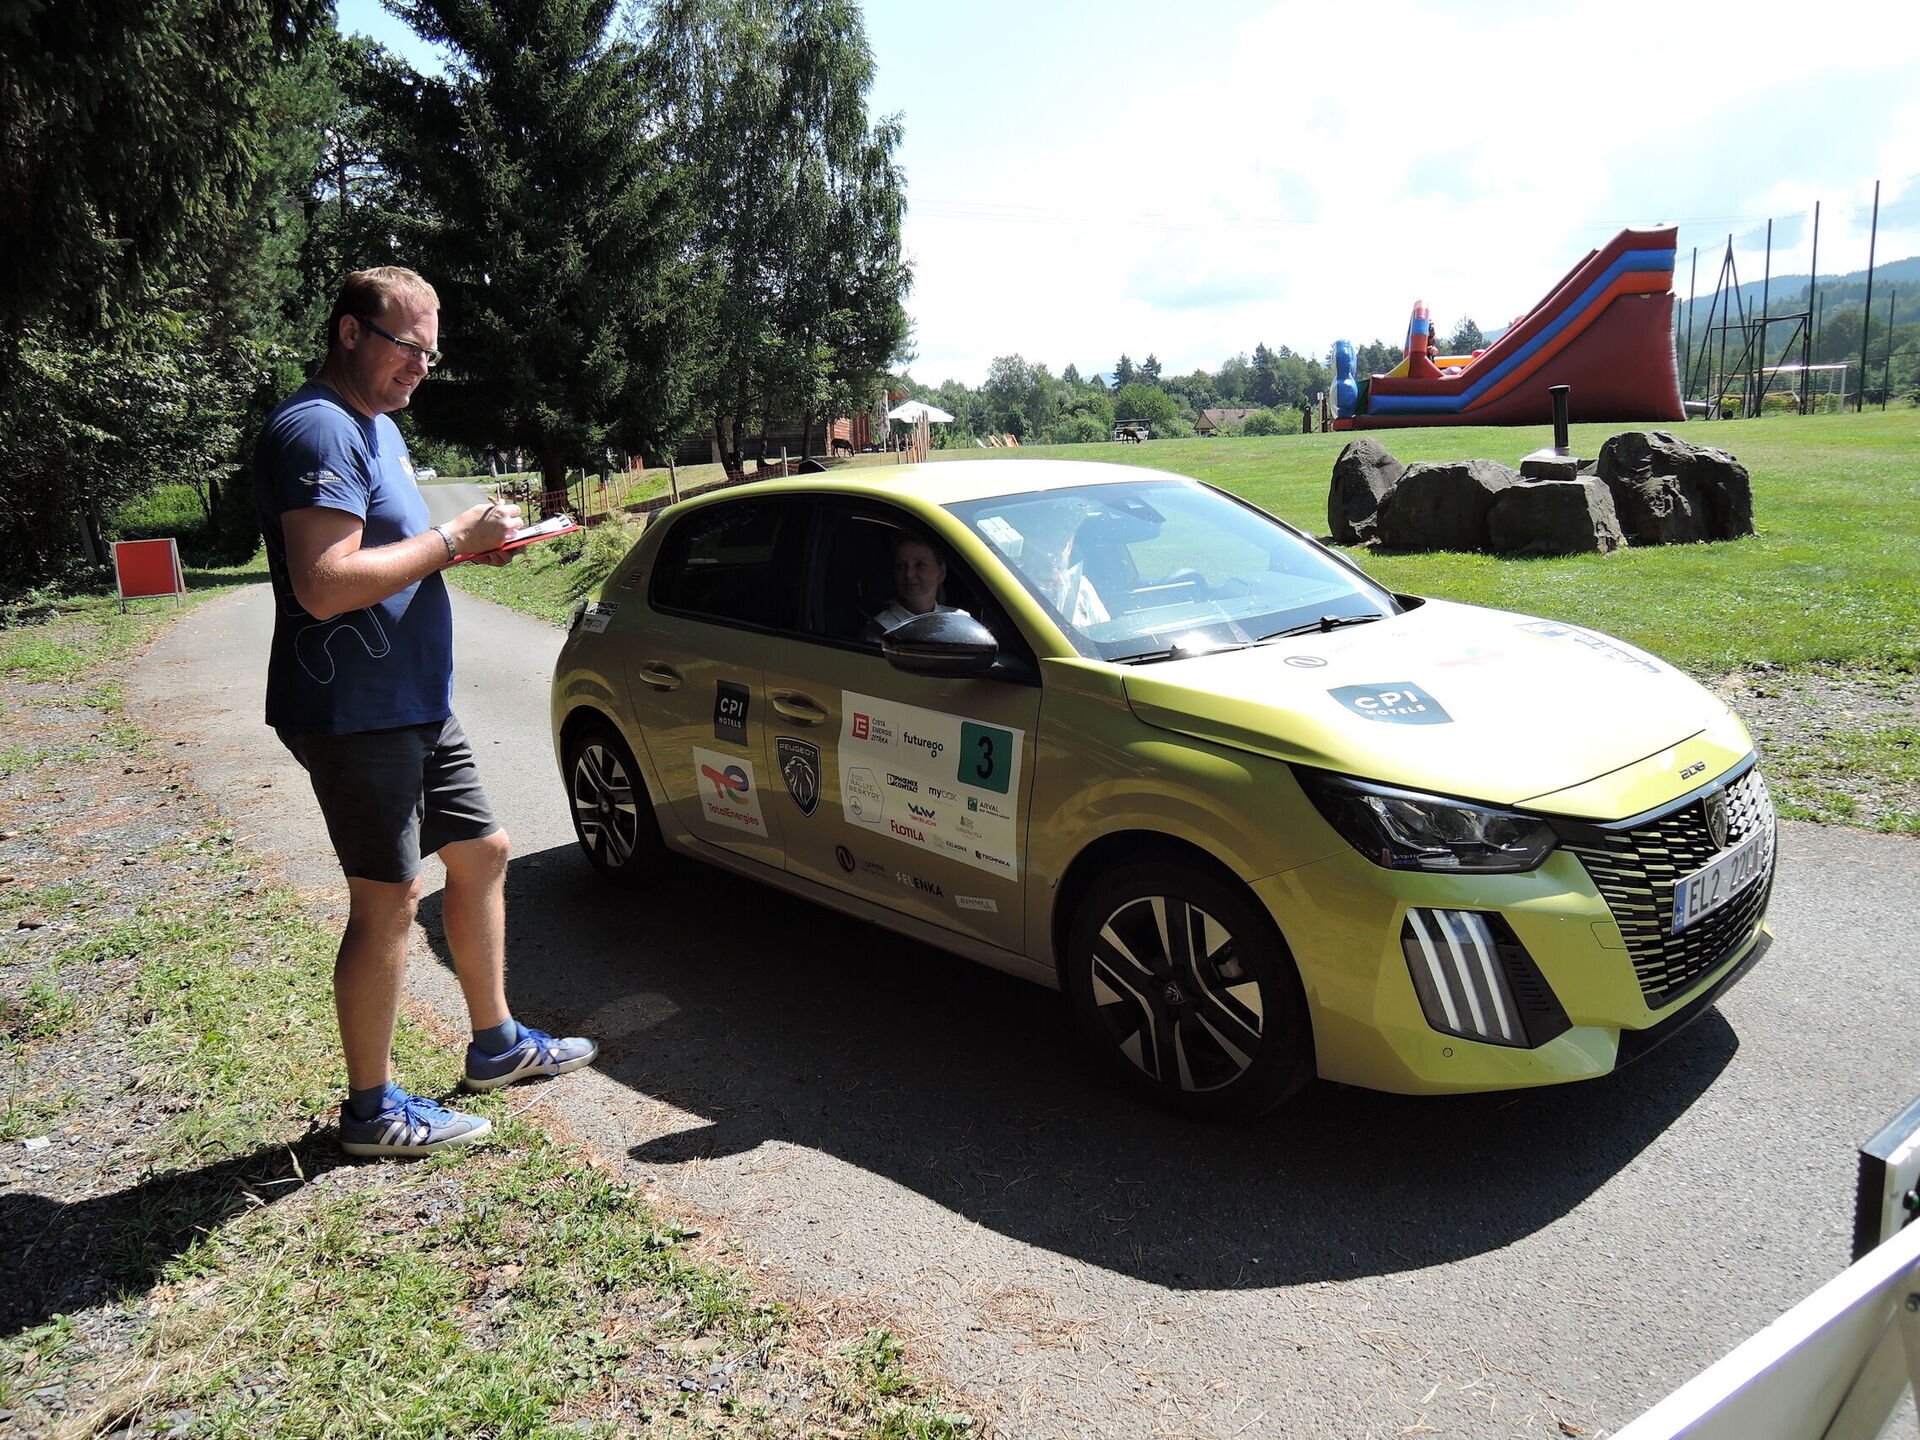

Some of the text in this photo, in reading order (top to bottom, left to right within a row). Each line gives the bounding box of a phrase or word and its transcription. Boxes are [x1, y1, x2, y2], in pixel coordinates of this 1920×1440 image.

[720, 697, 743, 717] CPI
[1353, 688, 1419, 711] CPI
[1364, 704, 1426, 718] HOTELS
[718, 716, 742, 729] HOTELS
[872, 726, 893, 738] ENERGIE
[778, 742, 816, 758] PEUGEOT
[903, 732, 944, 758] futurego
[976, 735, 994, 780] 3
[1678, 761, 1706, 781] 208
[849, 778, 875, 792] RALLYE
[894, 775, 919, 787] PHOENIX
[894, 781, 919, 794] CONTACT
[848, 785, 880, 800] BESKYDY
[706, 802, 760, 826] TotalEnergies
[979, 802, 1000, 813] ARVAL
[890, 819, 925, 843] FLOTILA
[1688, 868, 1721, 919] EL2
